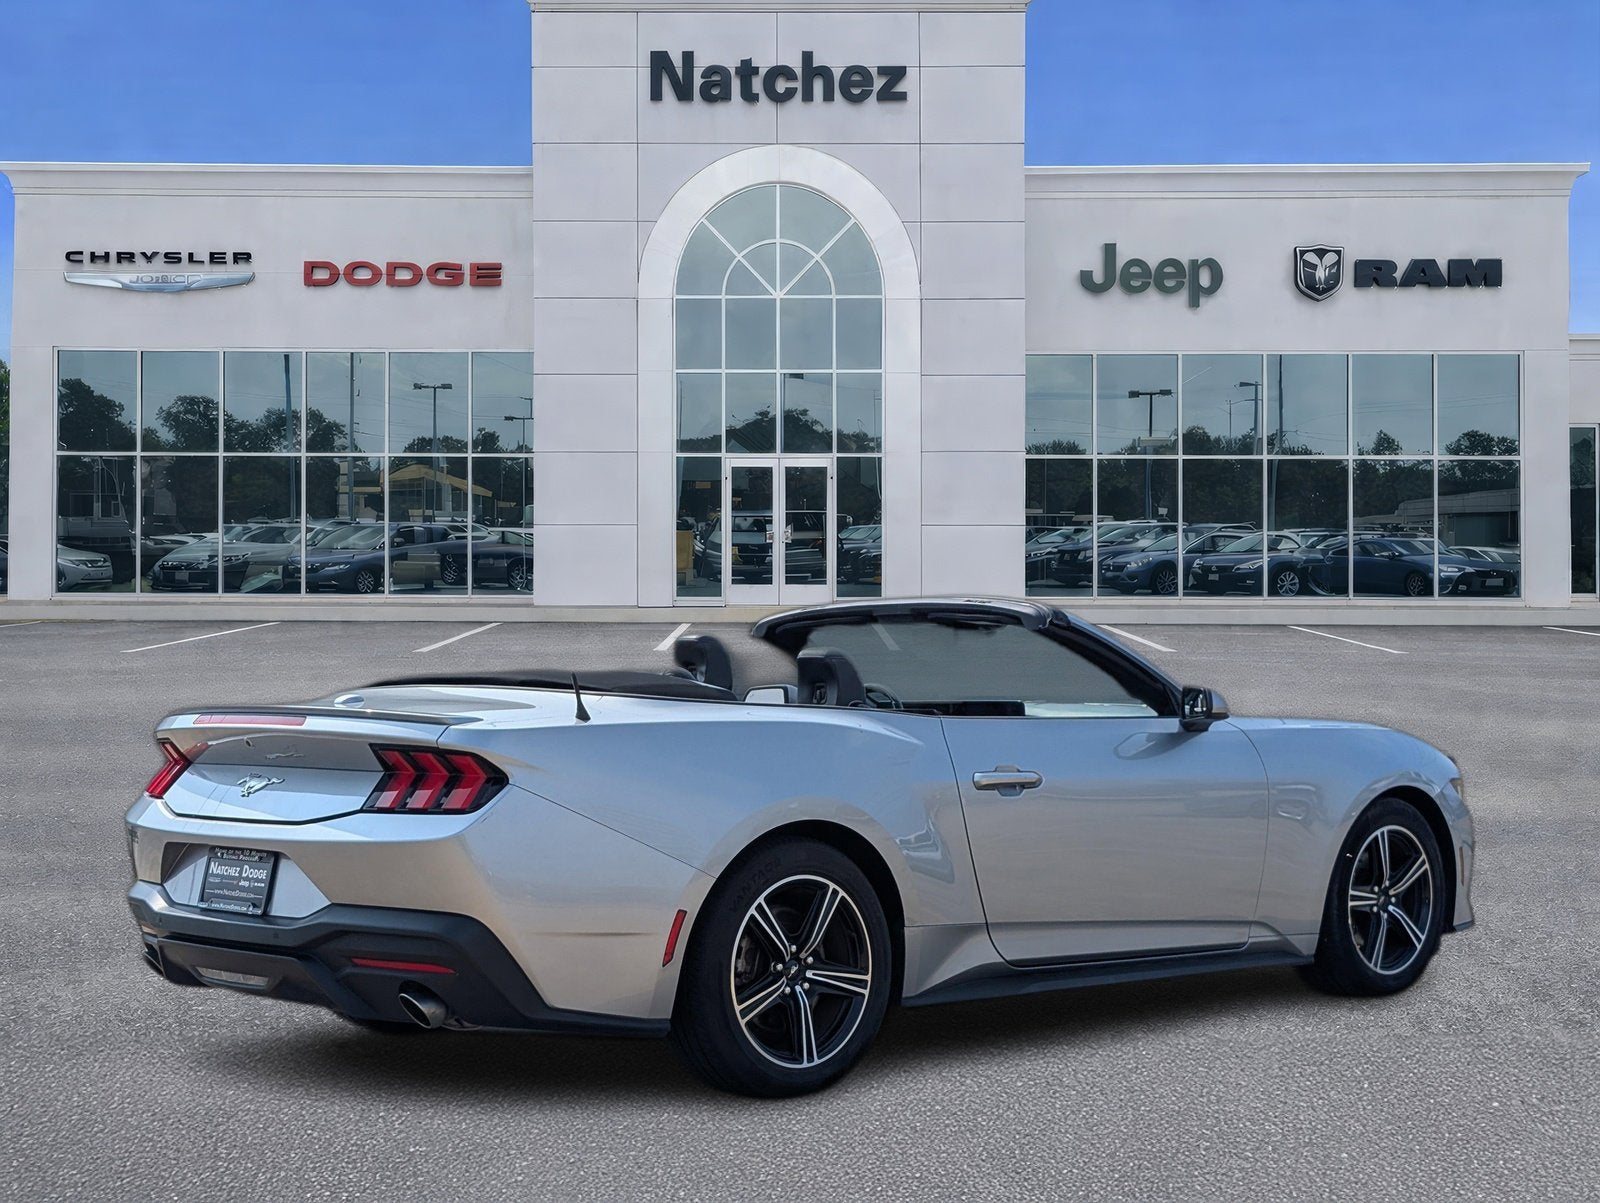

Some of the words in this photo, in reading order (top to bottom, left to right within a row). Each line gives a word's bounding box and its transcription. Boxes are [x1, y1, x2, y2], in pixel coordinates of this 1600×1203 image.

[650, 50, 908, 103] Natchez
[65, 251, 253, 265] CHRYSLER
[1354, 258, 1503, 288] RAM
[303, 261, 502, 287] DODGE
[1079, 243, 1224, 308] Jeep
